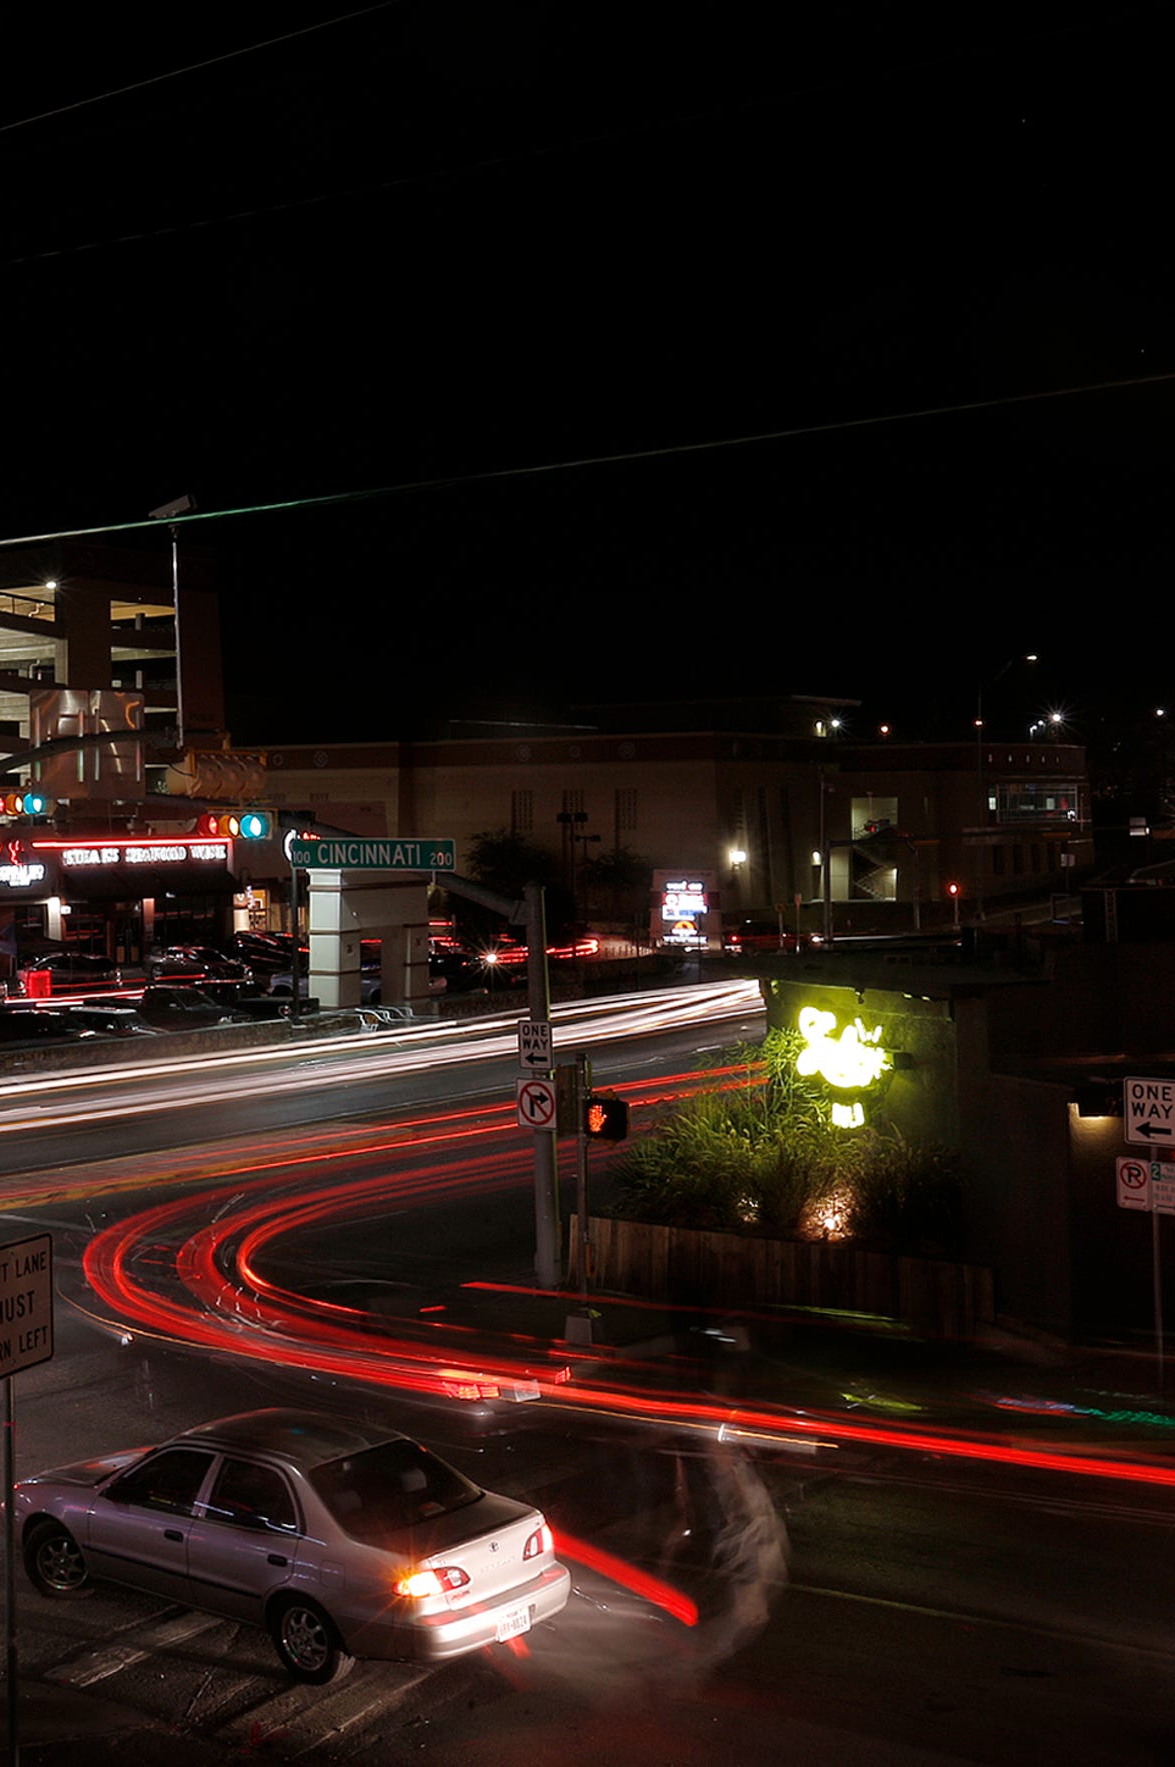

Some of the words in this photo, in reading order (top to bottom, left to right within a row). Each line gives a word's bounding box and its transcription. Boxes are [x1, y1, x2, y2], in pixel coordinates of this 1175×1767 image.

[293, 850, 311, 864] 100
[317, 843, 421, 866] CINCINNATI
[429, 851, 453, 866] 200
[522, 1025, 548, 1037] ONE
[523, 1039, 548, 1050] WAY
[1132, 1084, 1172, 1101] ONE
[1132, 1102, 1173, 1119] WAY
[16, 1251, 47, 1278] LANE
[19, 1326, 48, 1353] LEFT
